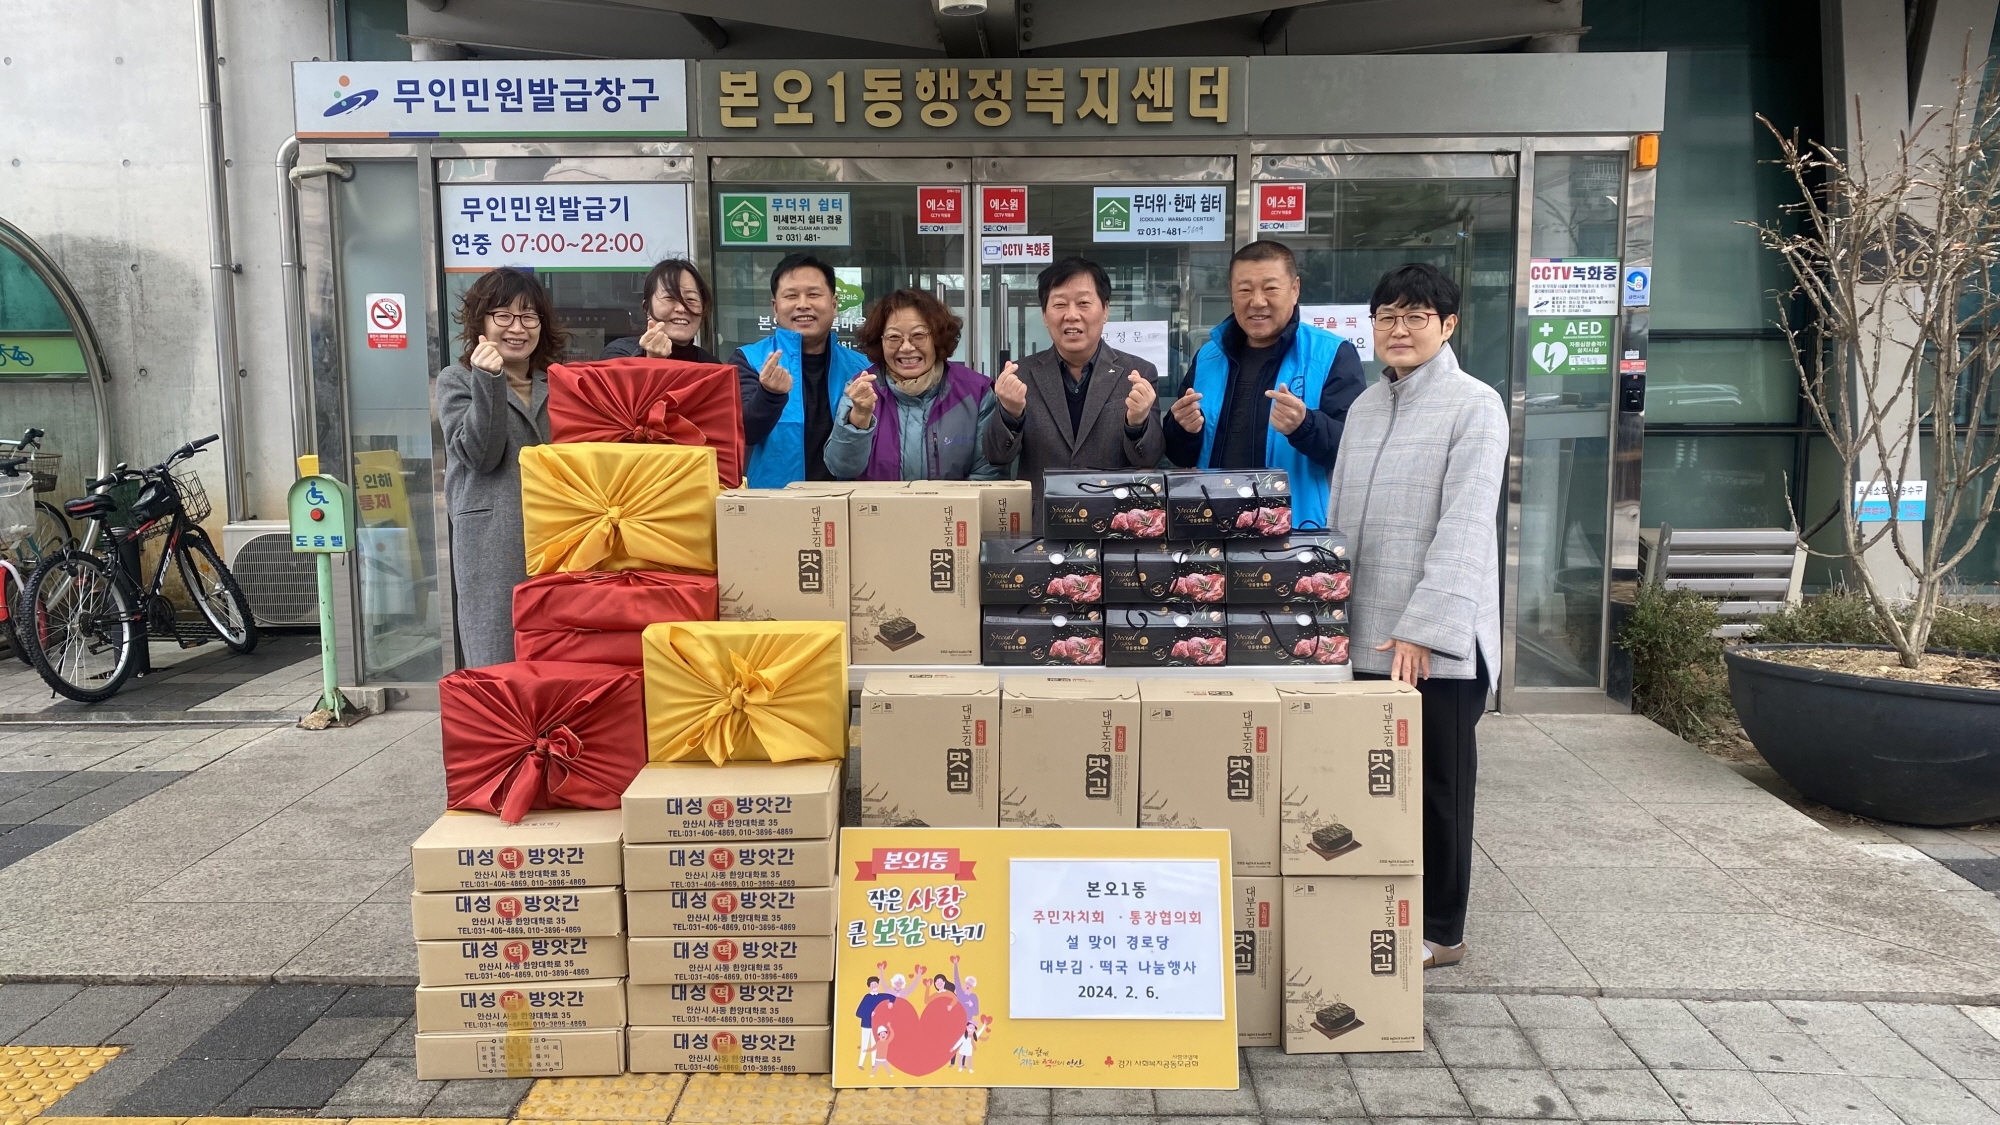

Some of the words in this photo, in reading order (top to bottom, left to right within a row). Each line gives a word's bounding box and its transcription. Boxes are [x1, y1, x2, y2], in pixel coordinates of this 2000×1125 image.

[393, 77, 660, 114] 무인민원발급창구
[719, 66, 1229, 129] 본오1동행정복지센터
[460, 195, 630, 223] 무인민원발급기
[772, 198, 810, 212] 무더위
[818, 198, 843, 212] 쉼터
[926, 198, 955, 211] 에스원
[989, 198, 1019, 211] 에스원
[1200, 194, 1222, 213] 쉼터
[1266, 196, 1296, 208] 에스원
[773, 214, 805, 224] 미세먼지
[808, 214, 824, 224] 쉼터
[826, 214, 843, 225] 겸용
[451, 233, 492, 256] 연중
[500, 232, 645, 253] 07:00~22:00
[1002, 243, 1023, 256] CCTV
[1026, 243, 1050, 256] 녹화중
[1345, 317, 1357, 328] 꼭
[1565, 321, 1602, 335] AED
[363, 473, 392, 489] 인해
[359, 493, 392, 511] 통제
[811, 505, 822, 548] 대부도김
[944, 505, 953, 547] 대부도김
[801, 552, 820, 590] 맛김
[932, 552, 952, 589] 맛김
[961, 704, 972, 747] 대부도김
[1101, 709, 1112, 753] 대부도김
[1242, 710, 1253, 754] 대부도김
[1382, 702, 1394, 747] 대부도김
[950, 752, 970, 791] 맛김
[1088, 756, 1108, 795] 맛김
[1230, 759, 1251, 798] 맛김
[1370, 753, 1392, 792] 맛김
[666, 797, 703, 815] 대성
[712, 801, 729, 818] 떡
[736, 796, 793, 815] 방앗간
[682, 819, 706, 828] 안산시
[708, 819, 724, 828] 사동
[727, 819, 766, 827] 한양대학로
[458, 849, 494, 866] 대성
[500, 850, 518, 868] 떡
[528, 847, 585, 865] 방앗간
[669, 849, 705, 867] 대성
[714, 851, 729, 868] 떡
[739, 848, 795, 866] 방앗간
[883, 851, 949, 871] 본오1동
[474, 870, 498, 879] 안산시
[501, 870, 516, 879] 사동
[519, 870, 558, 878] 한양대학로
[685, 871, 708, 880] 안산시
[711, 871, 726, 880] 사동
[729, 871, 768, 879] 한양대학로
[1086, 881, 1147, 899] 본오1동
[455, 896, 491, 913] 대성
[500, 899, 516, 917] 떡
[524, 895, 580, 913] 방앗간
[671, 892, 707, 910] 대성
[716, 894, 732, 912] 떡
[740, 891, 796, 910] 방앗간
[868, 889, 902, 911] 작은
[907, 886, 965, 919] 사랑
[1245, 885, 1256, 929] 대부도김
[1385, 883, 1396, 928] 대부도김
[472, 917, 495, 926] 안산시
[497, 917, 513, 926] 사동
[515, 917, 554, 926] 한양대학로
[556, 917, 566, 925] 35
[687, 914, 710, 922] 안산시
[712, 914, 728, 922] 사동
[730, 913, 769, 922] 한양대학로
[1032, 910, 1105, 924] 주민자치회
[848, 921, 867, 946] 큰
[874, 917, 926, 946] 보람
[930, 924, 985, 945] 나누기
[673, 941, 709, 959] 대성
[716, 942, 732, 960] 떡
[742, 941, 798, 959] 방앗간
[1066, 935, 1079, 950] 설
[1089, 935, 1117, 950] 맞이
[1126, 936, 1170, 950] 경로당
[1372, 933, 1393, 972] 맛김
[689, 964, 712, 972] 안산시
[714, 964, 730, 972] 사동
[732, 963, 771, 972] 한양대학로
[773, 963, 783, 971] 35
[1138, 961, 1197, 975] 나눔행사
[1078, 986, 1117, 1000] 2024.
[1125, 986, 1138, 1000] 2.
[1146, 986, 1159, 1000] 6.
[1118, 1060, 1132, 1069] 경기
